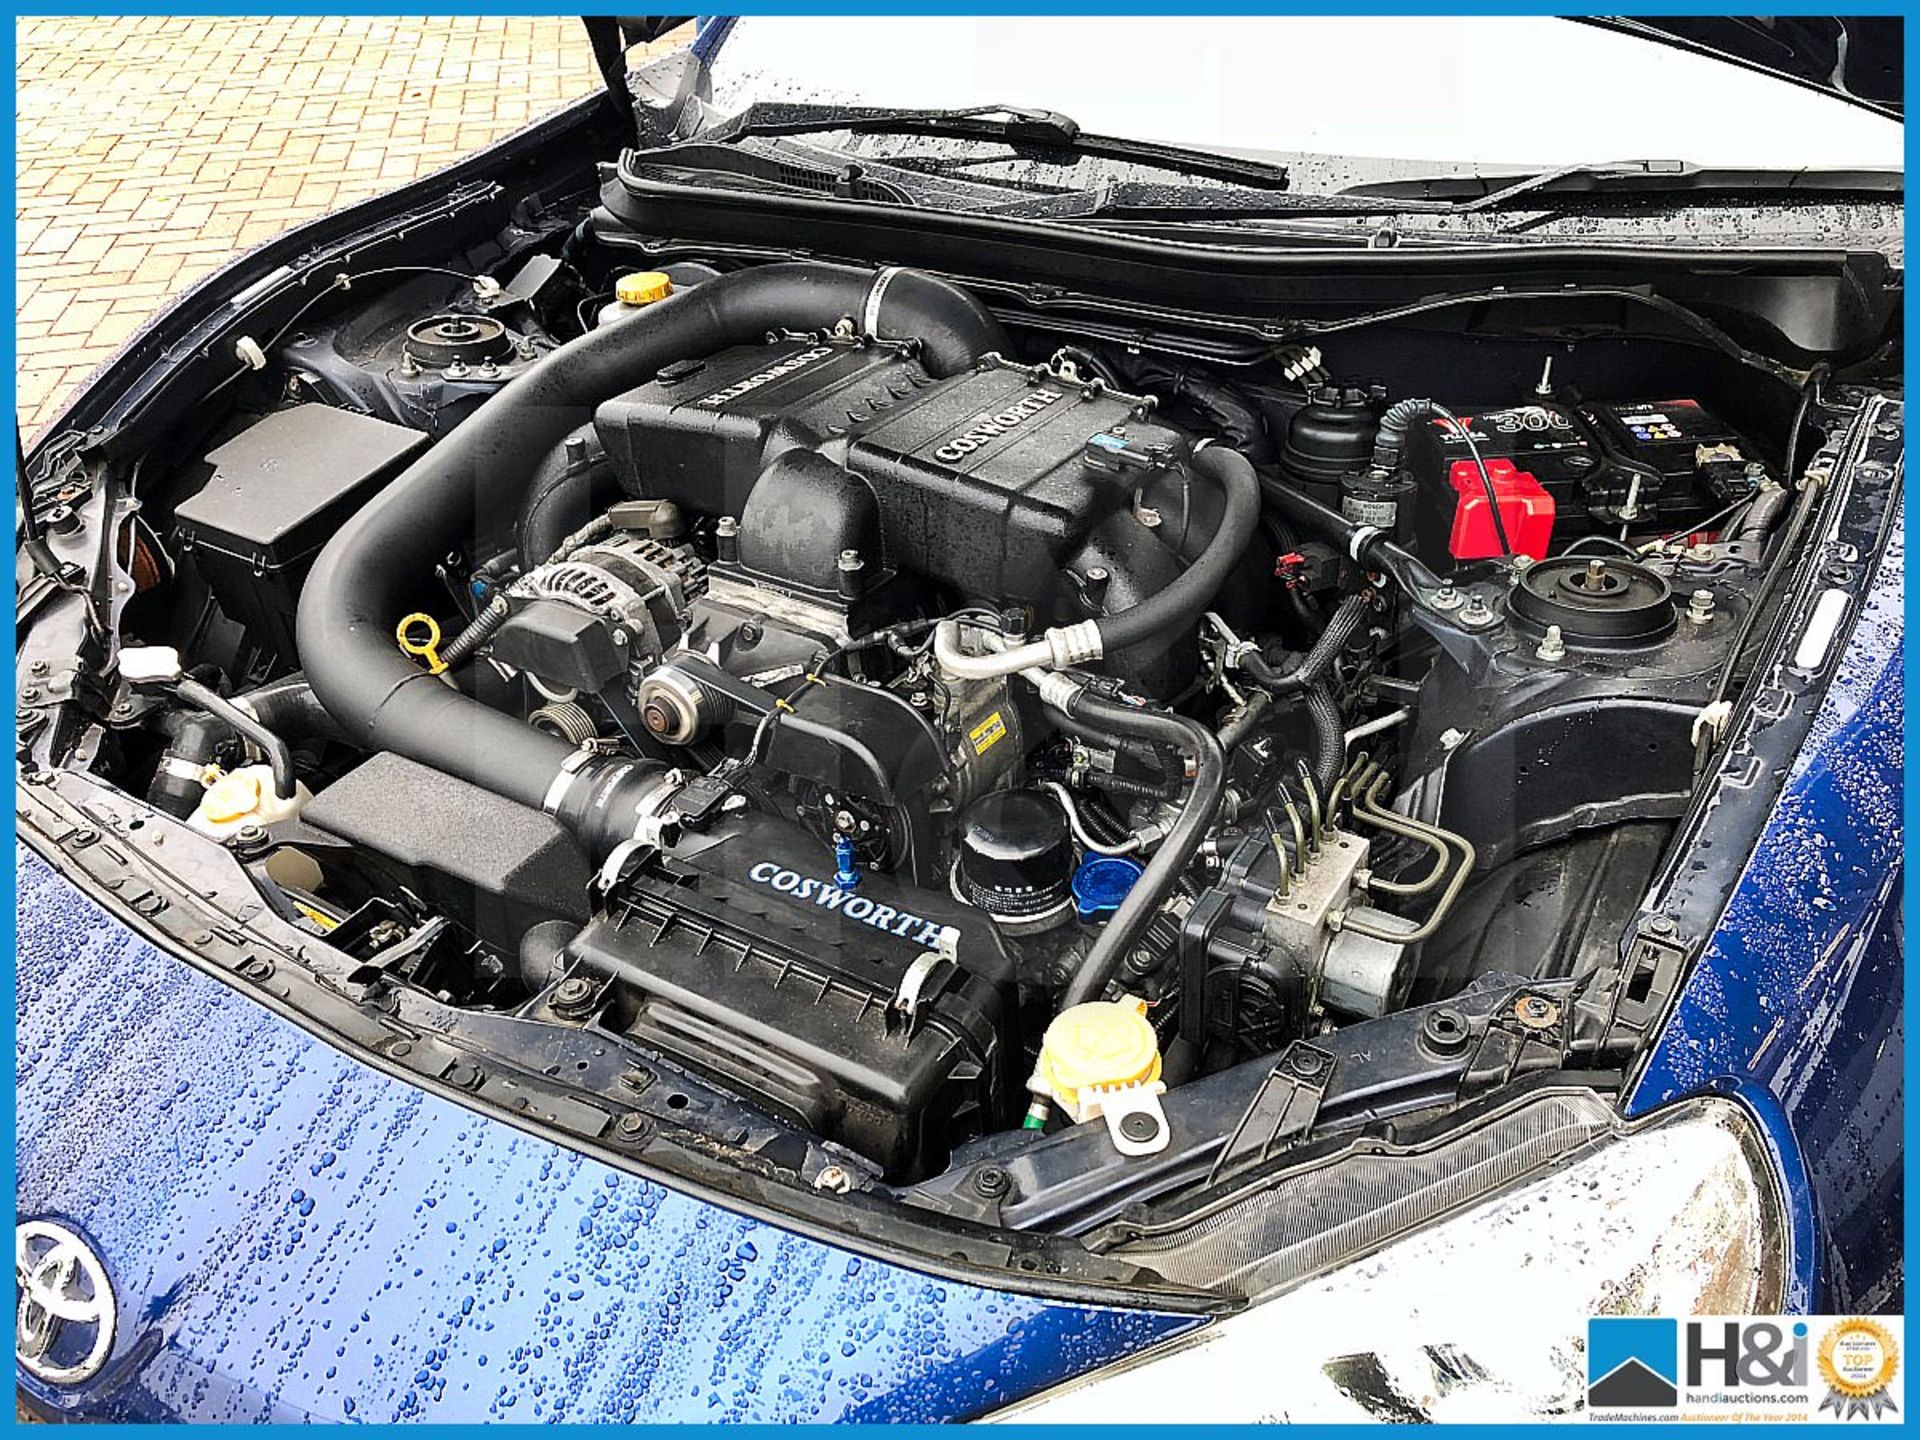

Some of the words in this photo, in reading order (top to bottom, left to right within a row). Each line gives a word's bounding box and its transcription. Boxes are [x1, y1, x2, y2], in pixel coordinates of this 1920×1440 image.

[698, 346, 833, 406] COSWORTH
[936, 388, 1063, 465] COSWORTH
[749, 862, 942, 949] COSWORTH
